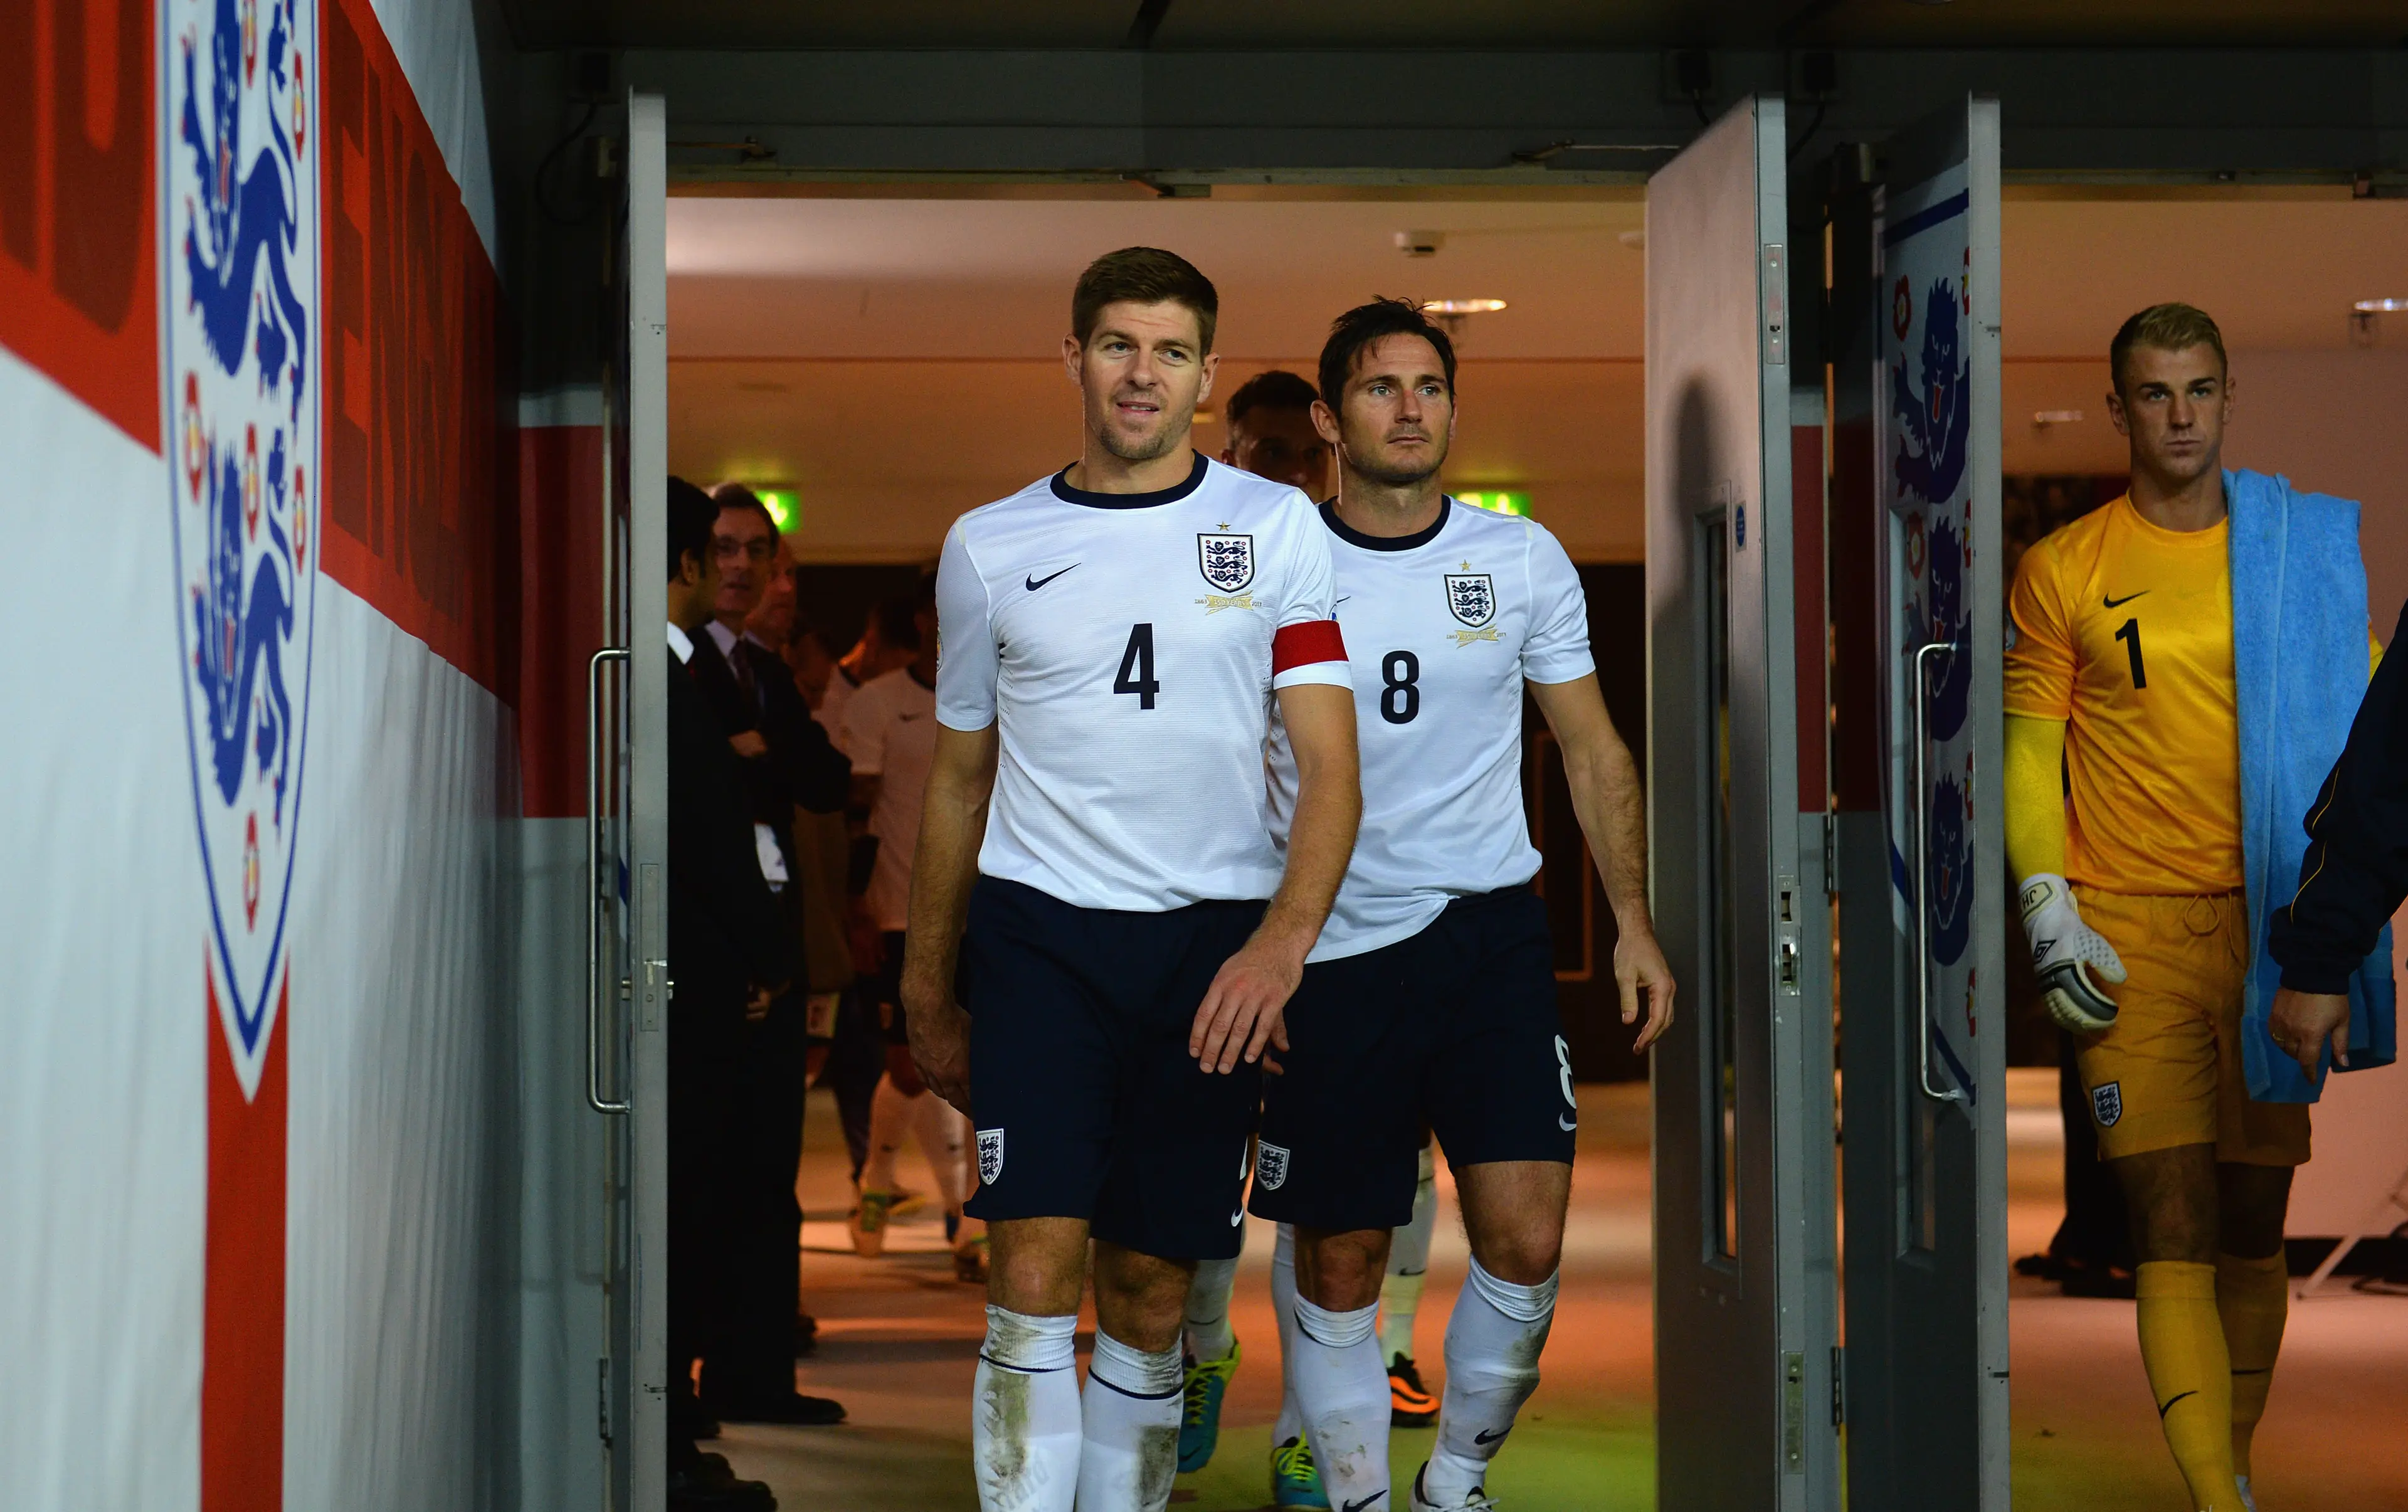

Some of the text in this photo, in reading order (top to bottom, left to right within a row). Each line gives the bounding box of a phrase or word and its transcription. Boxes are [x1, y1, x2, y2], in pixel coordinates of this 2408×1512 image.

[327, 0, 499, 638] ENGLA
[1113, 623, 1159, 709] 4
[1380, 650, 1420, 724] 8
[2115, 618, 2147, 689] 1
[1555, 1035, 1576, 1109] 8
